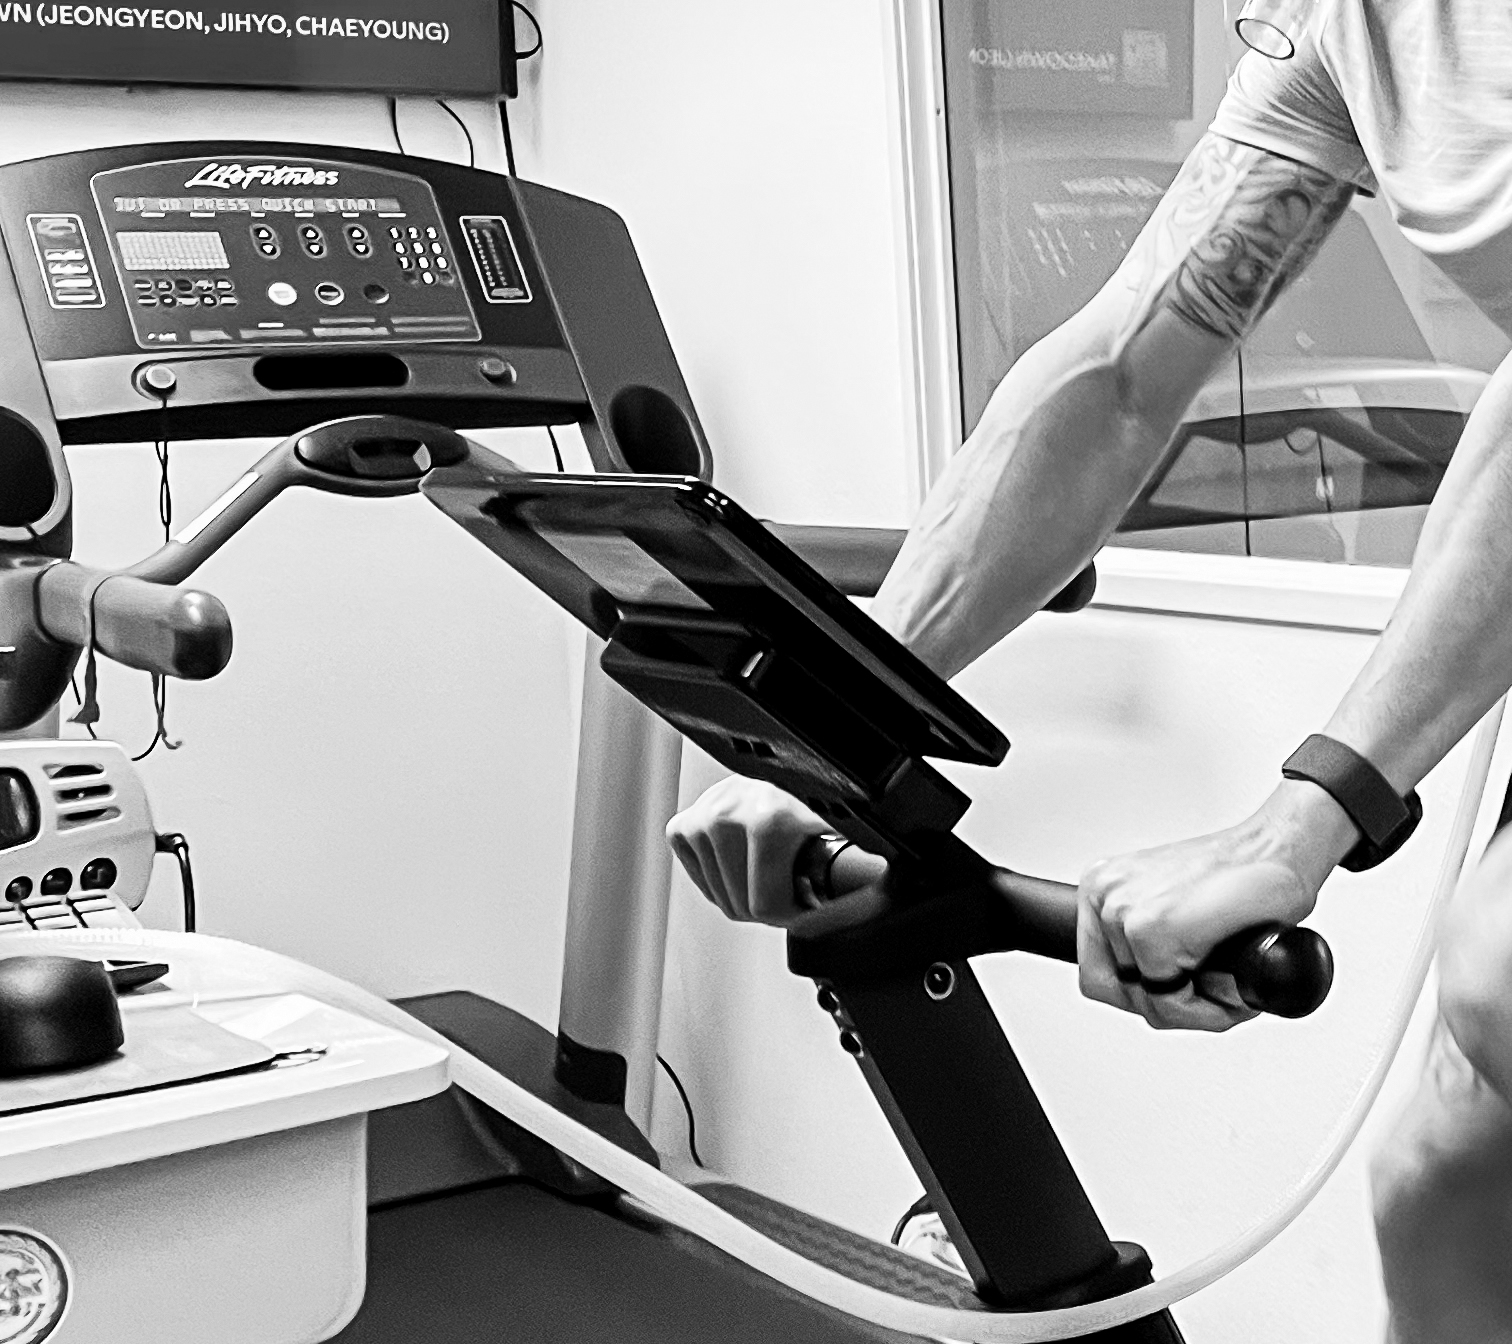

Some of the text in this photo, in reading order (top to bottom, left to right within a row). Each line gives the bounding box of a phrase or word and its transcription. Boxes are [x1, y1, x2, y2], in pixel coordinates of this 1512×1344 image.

[36, 2, 210, 35] (JEONGYEON,
[214, 11, 292, 38] JIHYO,
[295, 15, 450, 44] CHAEYOUNG)
[193, 198, 249, 211] PRESS
